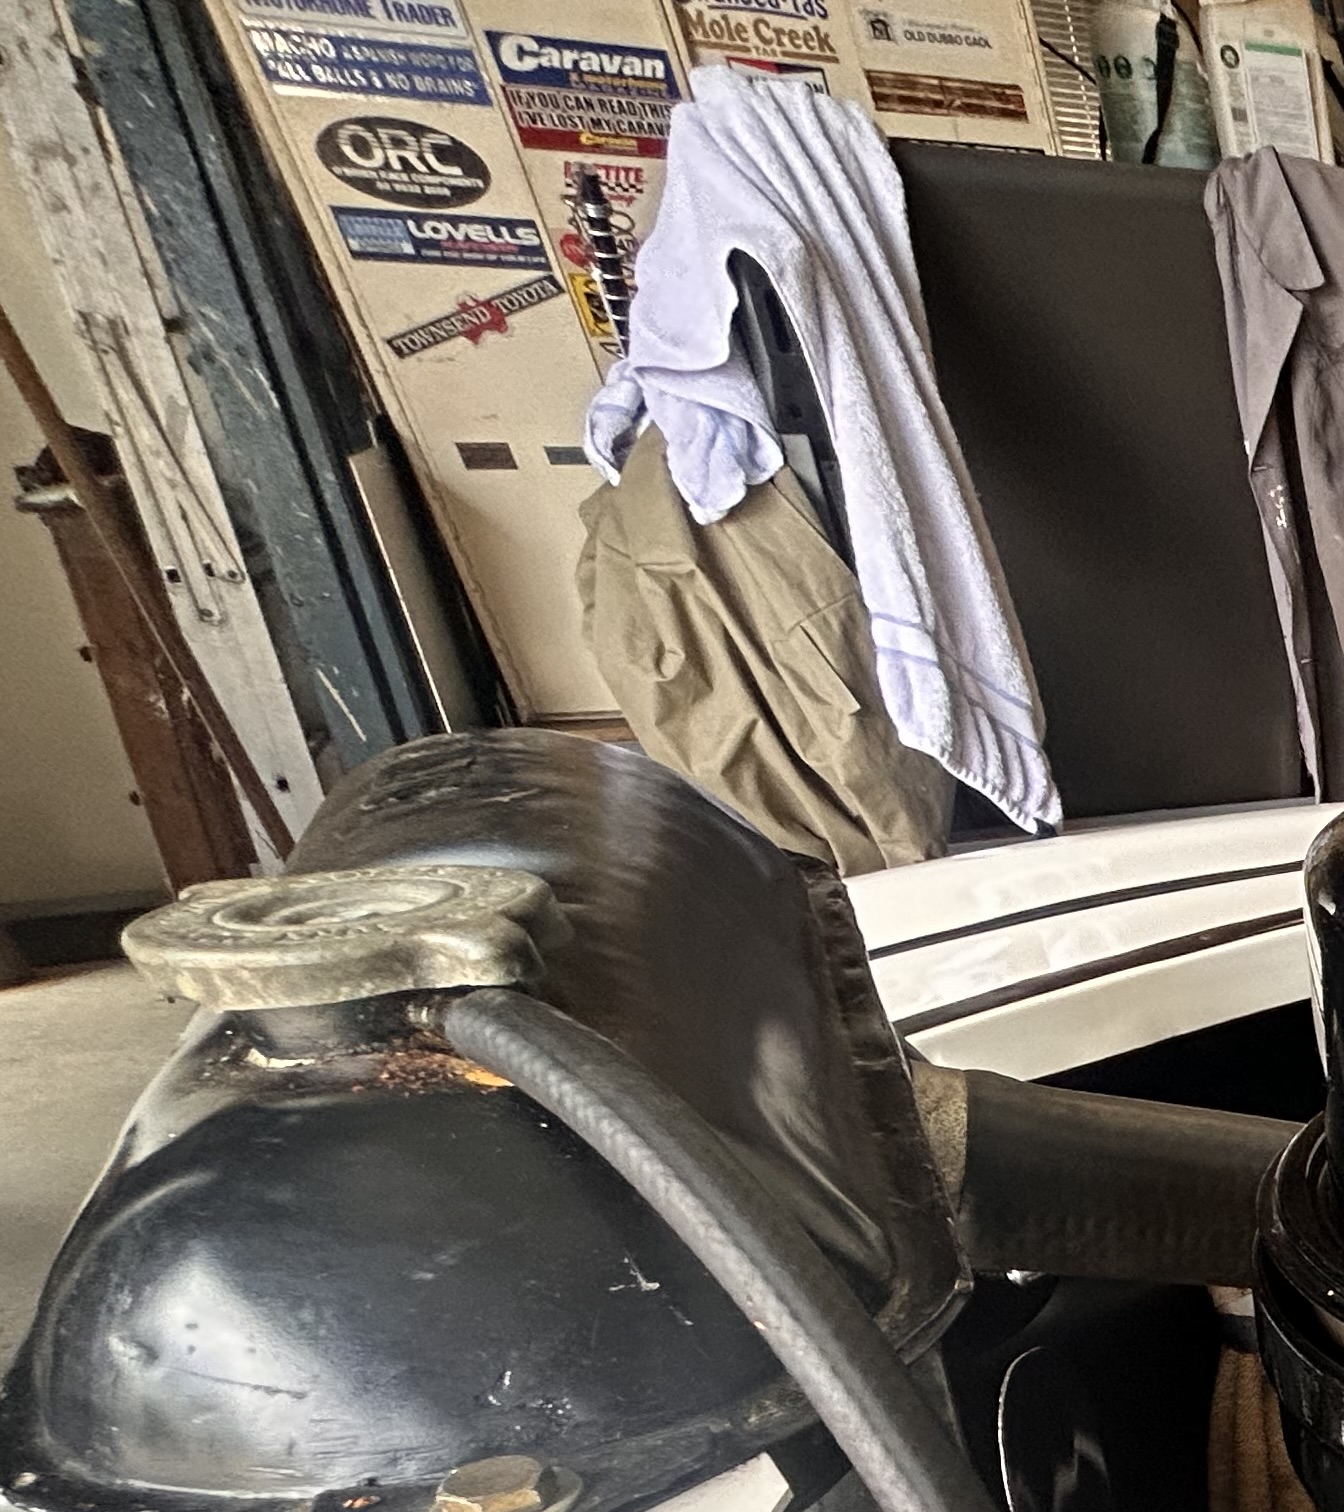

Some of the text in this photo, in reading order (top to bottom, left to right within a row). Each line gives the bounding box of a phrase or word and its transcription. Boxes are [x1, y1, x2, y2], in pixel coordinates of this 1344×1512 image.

[681, 7, 837, 54] Mole Creek
[499, 34, 666, 79] Caravan
[510, 91, 526, 107] IF
[527, 92, 562, 110] YOU
[563, 94, 596, 114] CAN
[597, 97, 638, 117] READ
[550, 112, 586, 130] LOST
[589, 117, 613, 133] MY
[338, 124, 463, 176] ORC
[406, 218, 541, 247] LOVELLS
[394, 280, 558, 355] TOWNSEND TOYOTA
